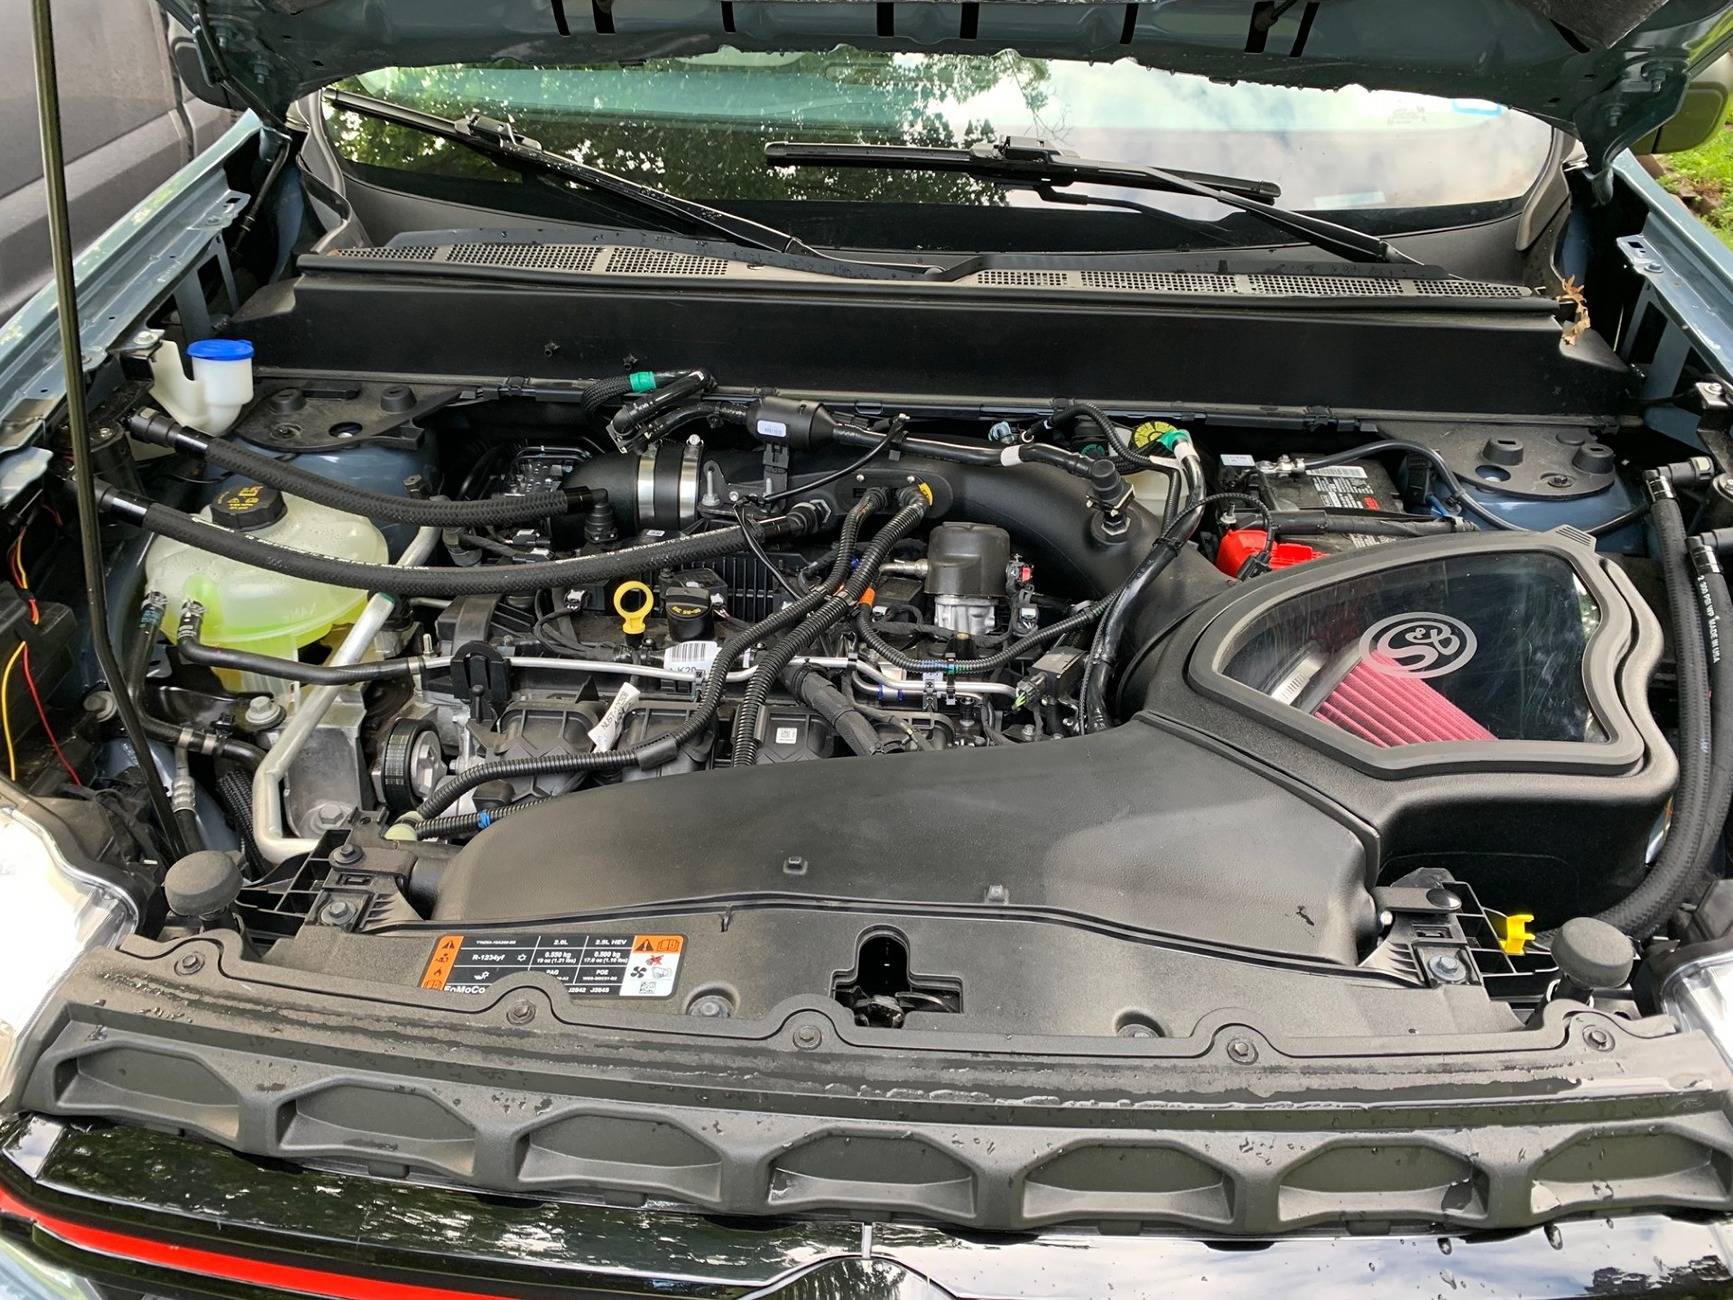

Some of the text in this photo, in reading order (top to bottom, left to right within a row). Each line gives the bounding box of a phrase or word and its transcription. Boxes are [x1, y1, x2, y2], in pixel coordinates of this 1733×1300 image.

[1708, 618, 1718, 640] MADE
[1712, 647, 1721, 664] USA
[472, 954, 506, 962] R-1234yf
[444, 985, 486, 994] FoMoCo
